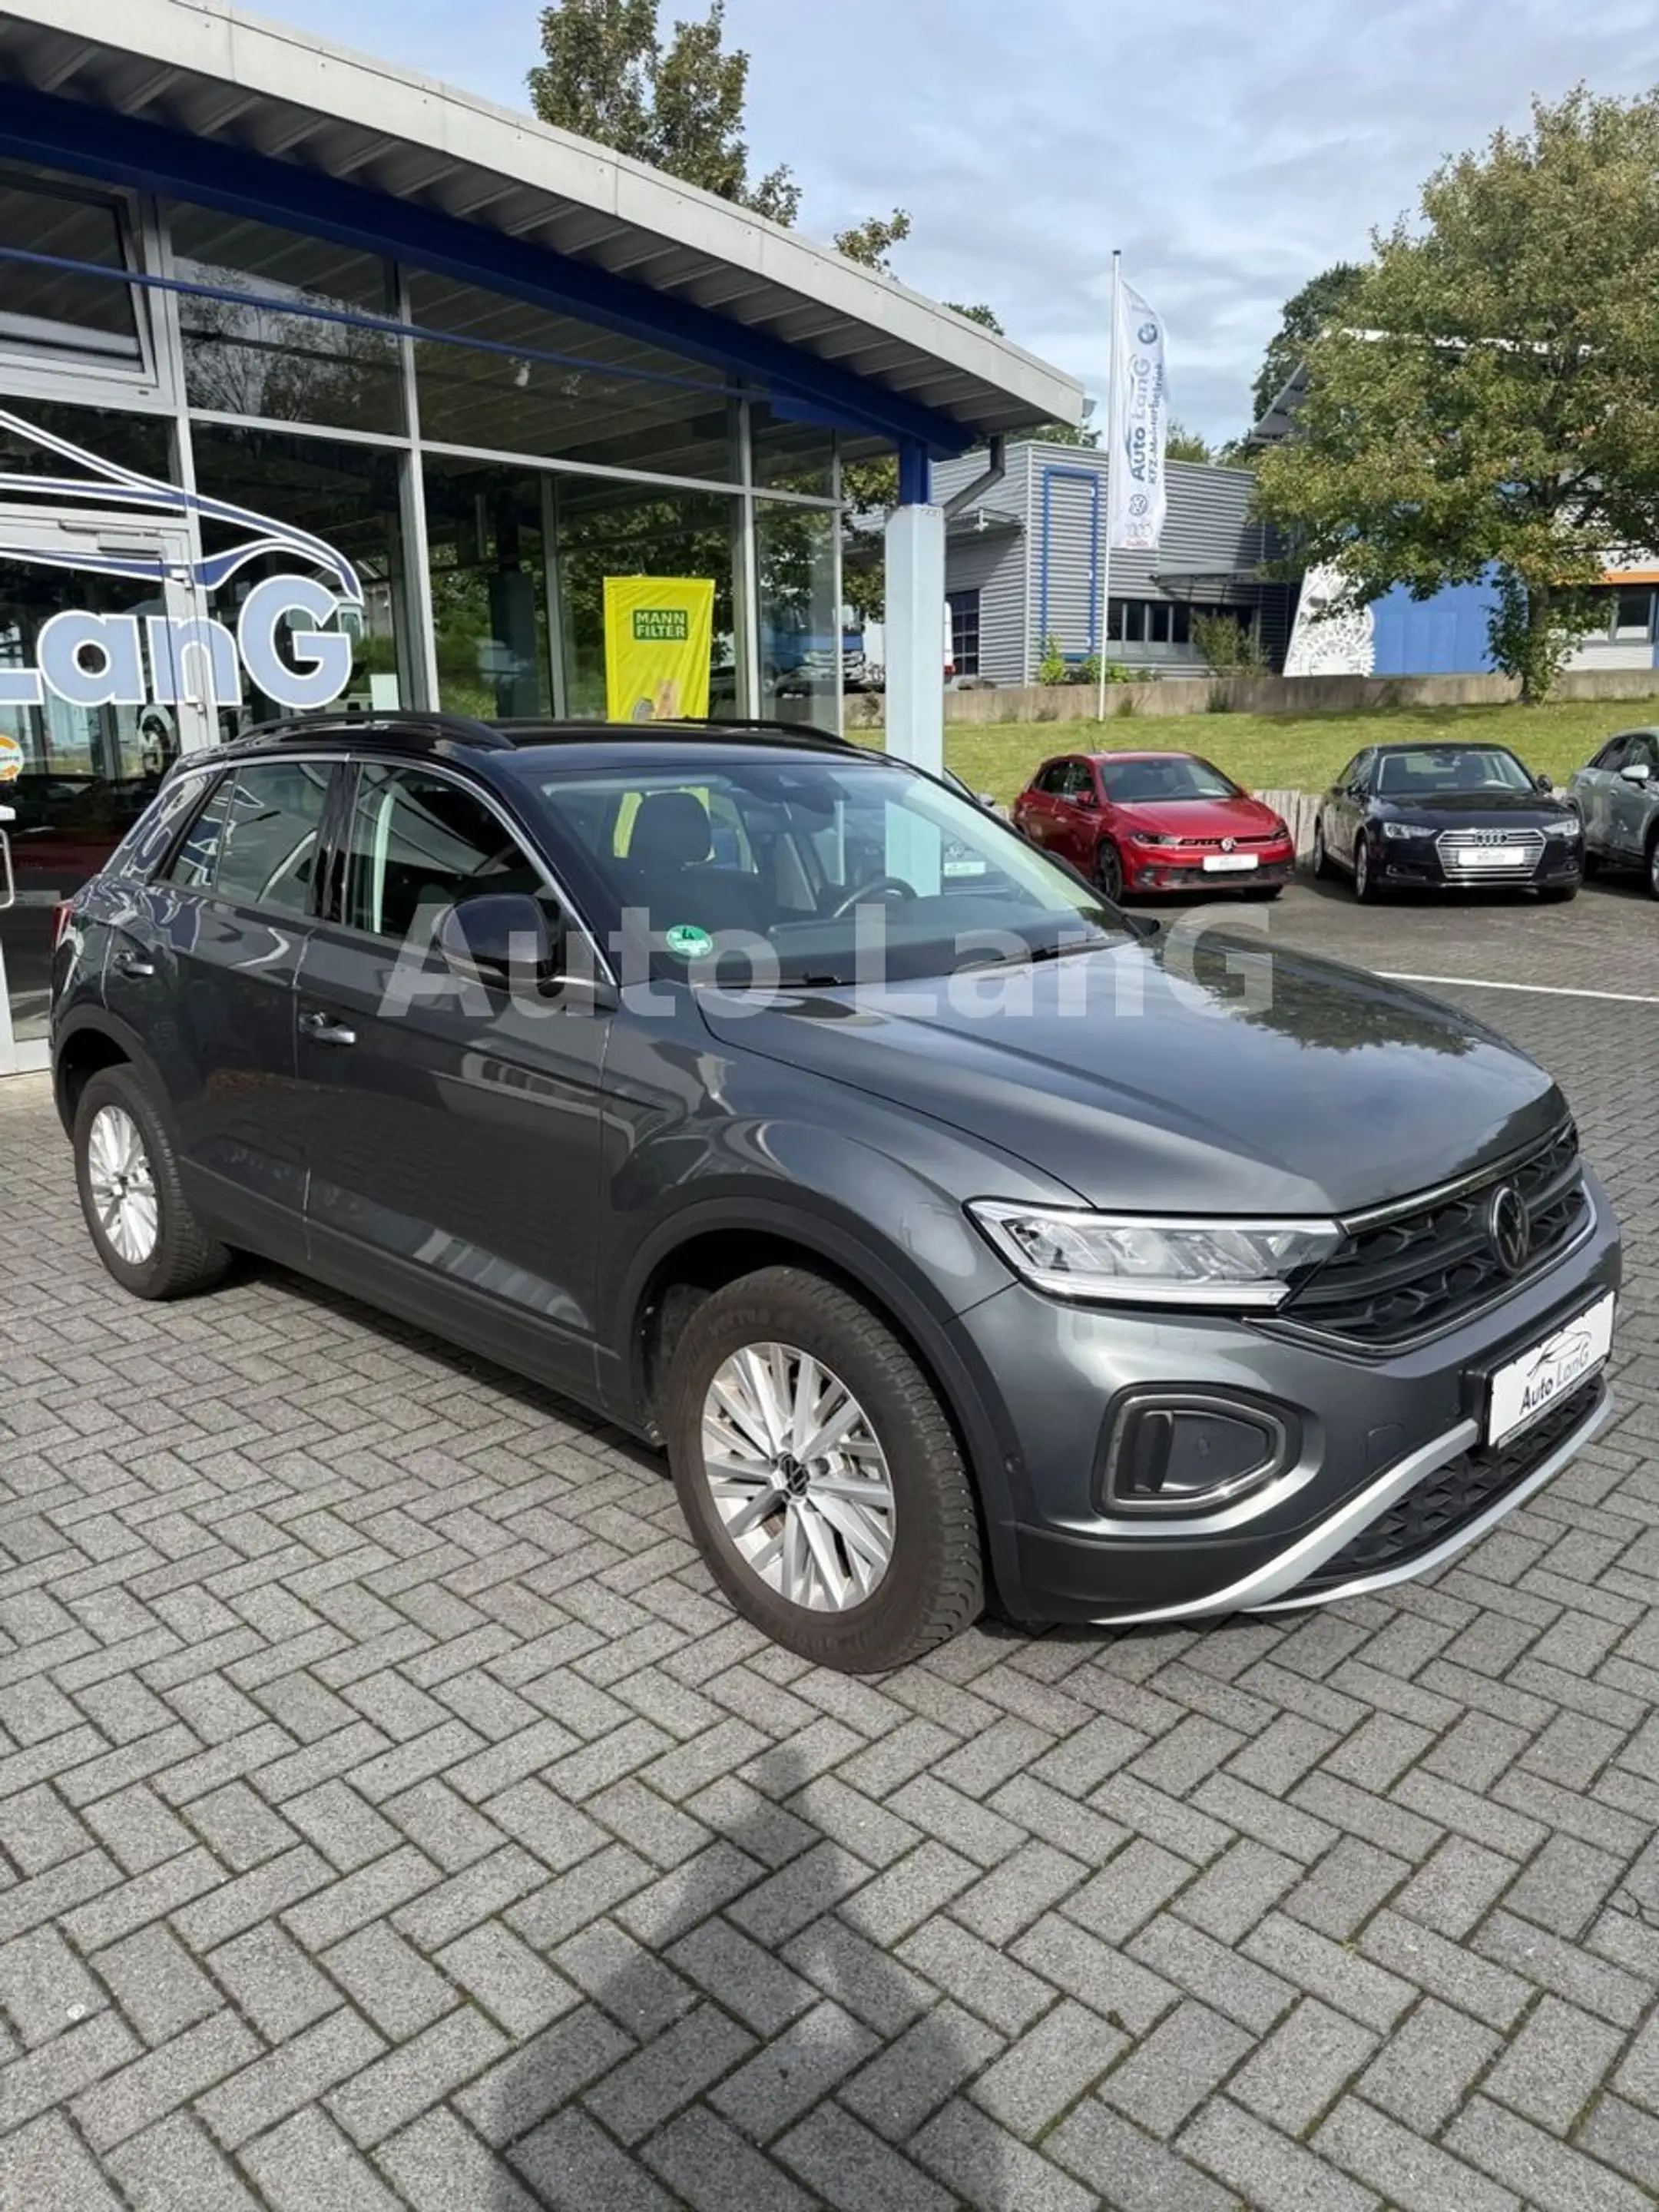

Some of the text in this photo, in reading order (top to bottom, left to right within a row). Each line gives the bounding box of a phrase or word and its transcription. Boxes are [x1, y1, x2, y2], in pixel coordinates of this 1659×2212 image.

[1131, 358, 1151, 482] Auto LanG
[635, 611, 685, 624] MANN
[636, 624, 685, 637] FILTER
[1519, 1341, 1591, 1416] Auto LanG
